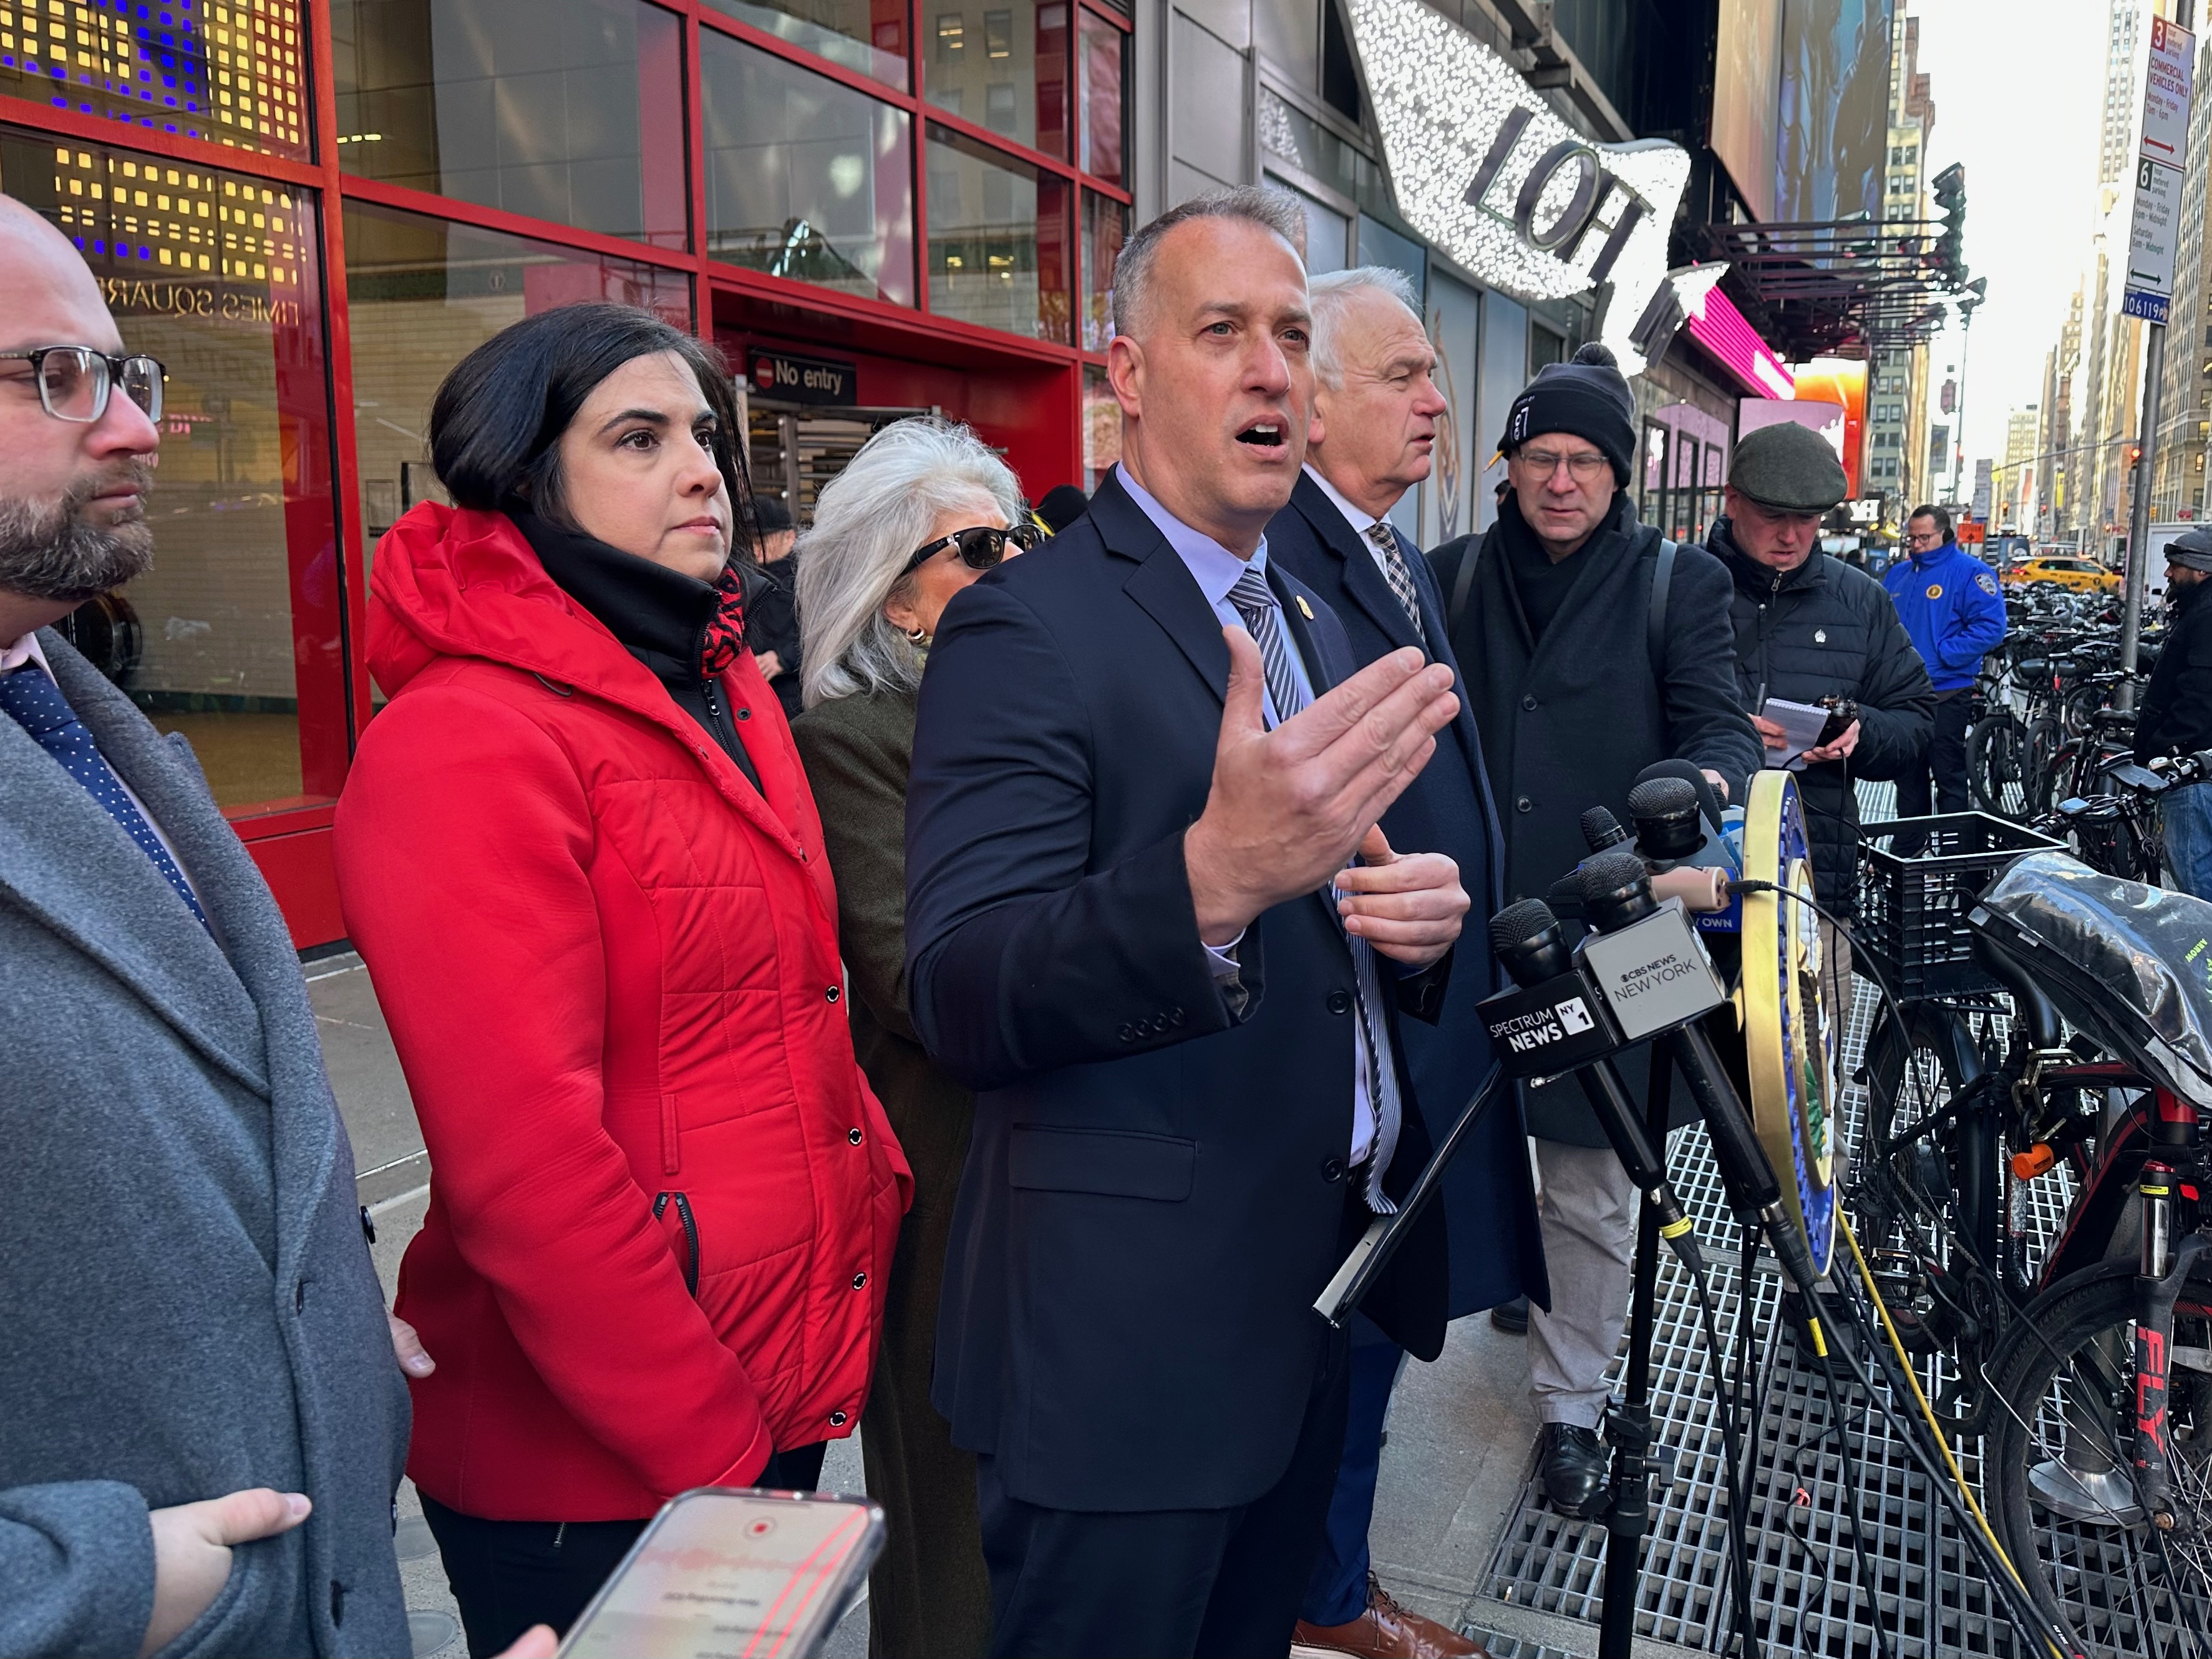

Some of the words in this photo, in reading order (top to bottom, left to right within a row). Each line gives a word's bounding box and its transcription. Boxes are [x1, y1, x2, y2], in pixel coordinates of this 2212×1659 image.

[2155, 21, 2163, 47] 3
[2151, 57, 2184, 82] COMMERCIAL
[2150, 72, 2174, 92] VEHICLES
[2175, 82, 2188, 98] ONLY
[2147, 91, 2163, 107] Monday
[2166, 99, 2179, 114] Friday
[2147, 104, 2155, 115] 7am
[2159, 109, 2168, 120] 6pm
[2140, 162, 2148, 187] 6
[1463, 106, 1656, 284] LOFT
[2137, 196, 2153, 211] Monday
[2157, 202, 2170, 216] Friday
[2135, 208, 2145, 220] 6pm
[2149, 213, 2167, 227] Midnight
[2134, 225, 2153, 241] Saturday
[2146, 241, 2164, 255] Midnight
[775, 359, 798, 386] No
[803, 367, 842, 396] entry
[1876, 559, 1885, 572] P
[1702, 918, 1732, 928] OWN
[2185, 938, 2208, 963] ARROW
[1629, 966, 1647, 979] CBS
[1647, 954, 1676, 971] NEWS
[1614, 976, 1650, 1002] NEW
[1651, 958, 1697, 985] YORK
[1560, 1003, 1574, 1016] NY
[1578, 1011, 1589, 1025] 1
[1490, 1008, 1554, 1038] SPECTRUM
[1508, 1023, 1563, 1053] NEWS
[2137, 1326, 2165, 1457] FLY
